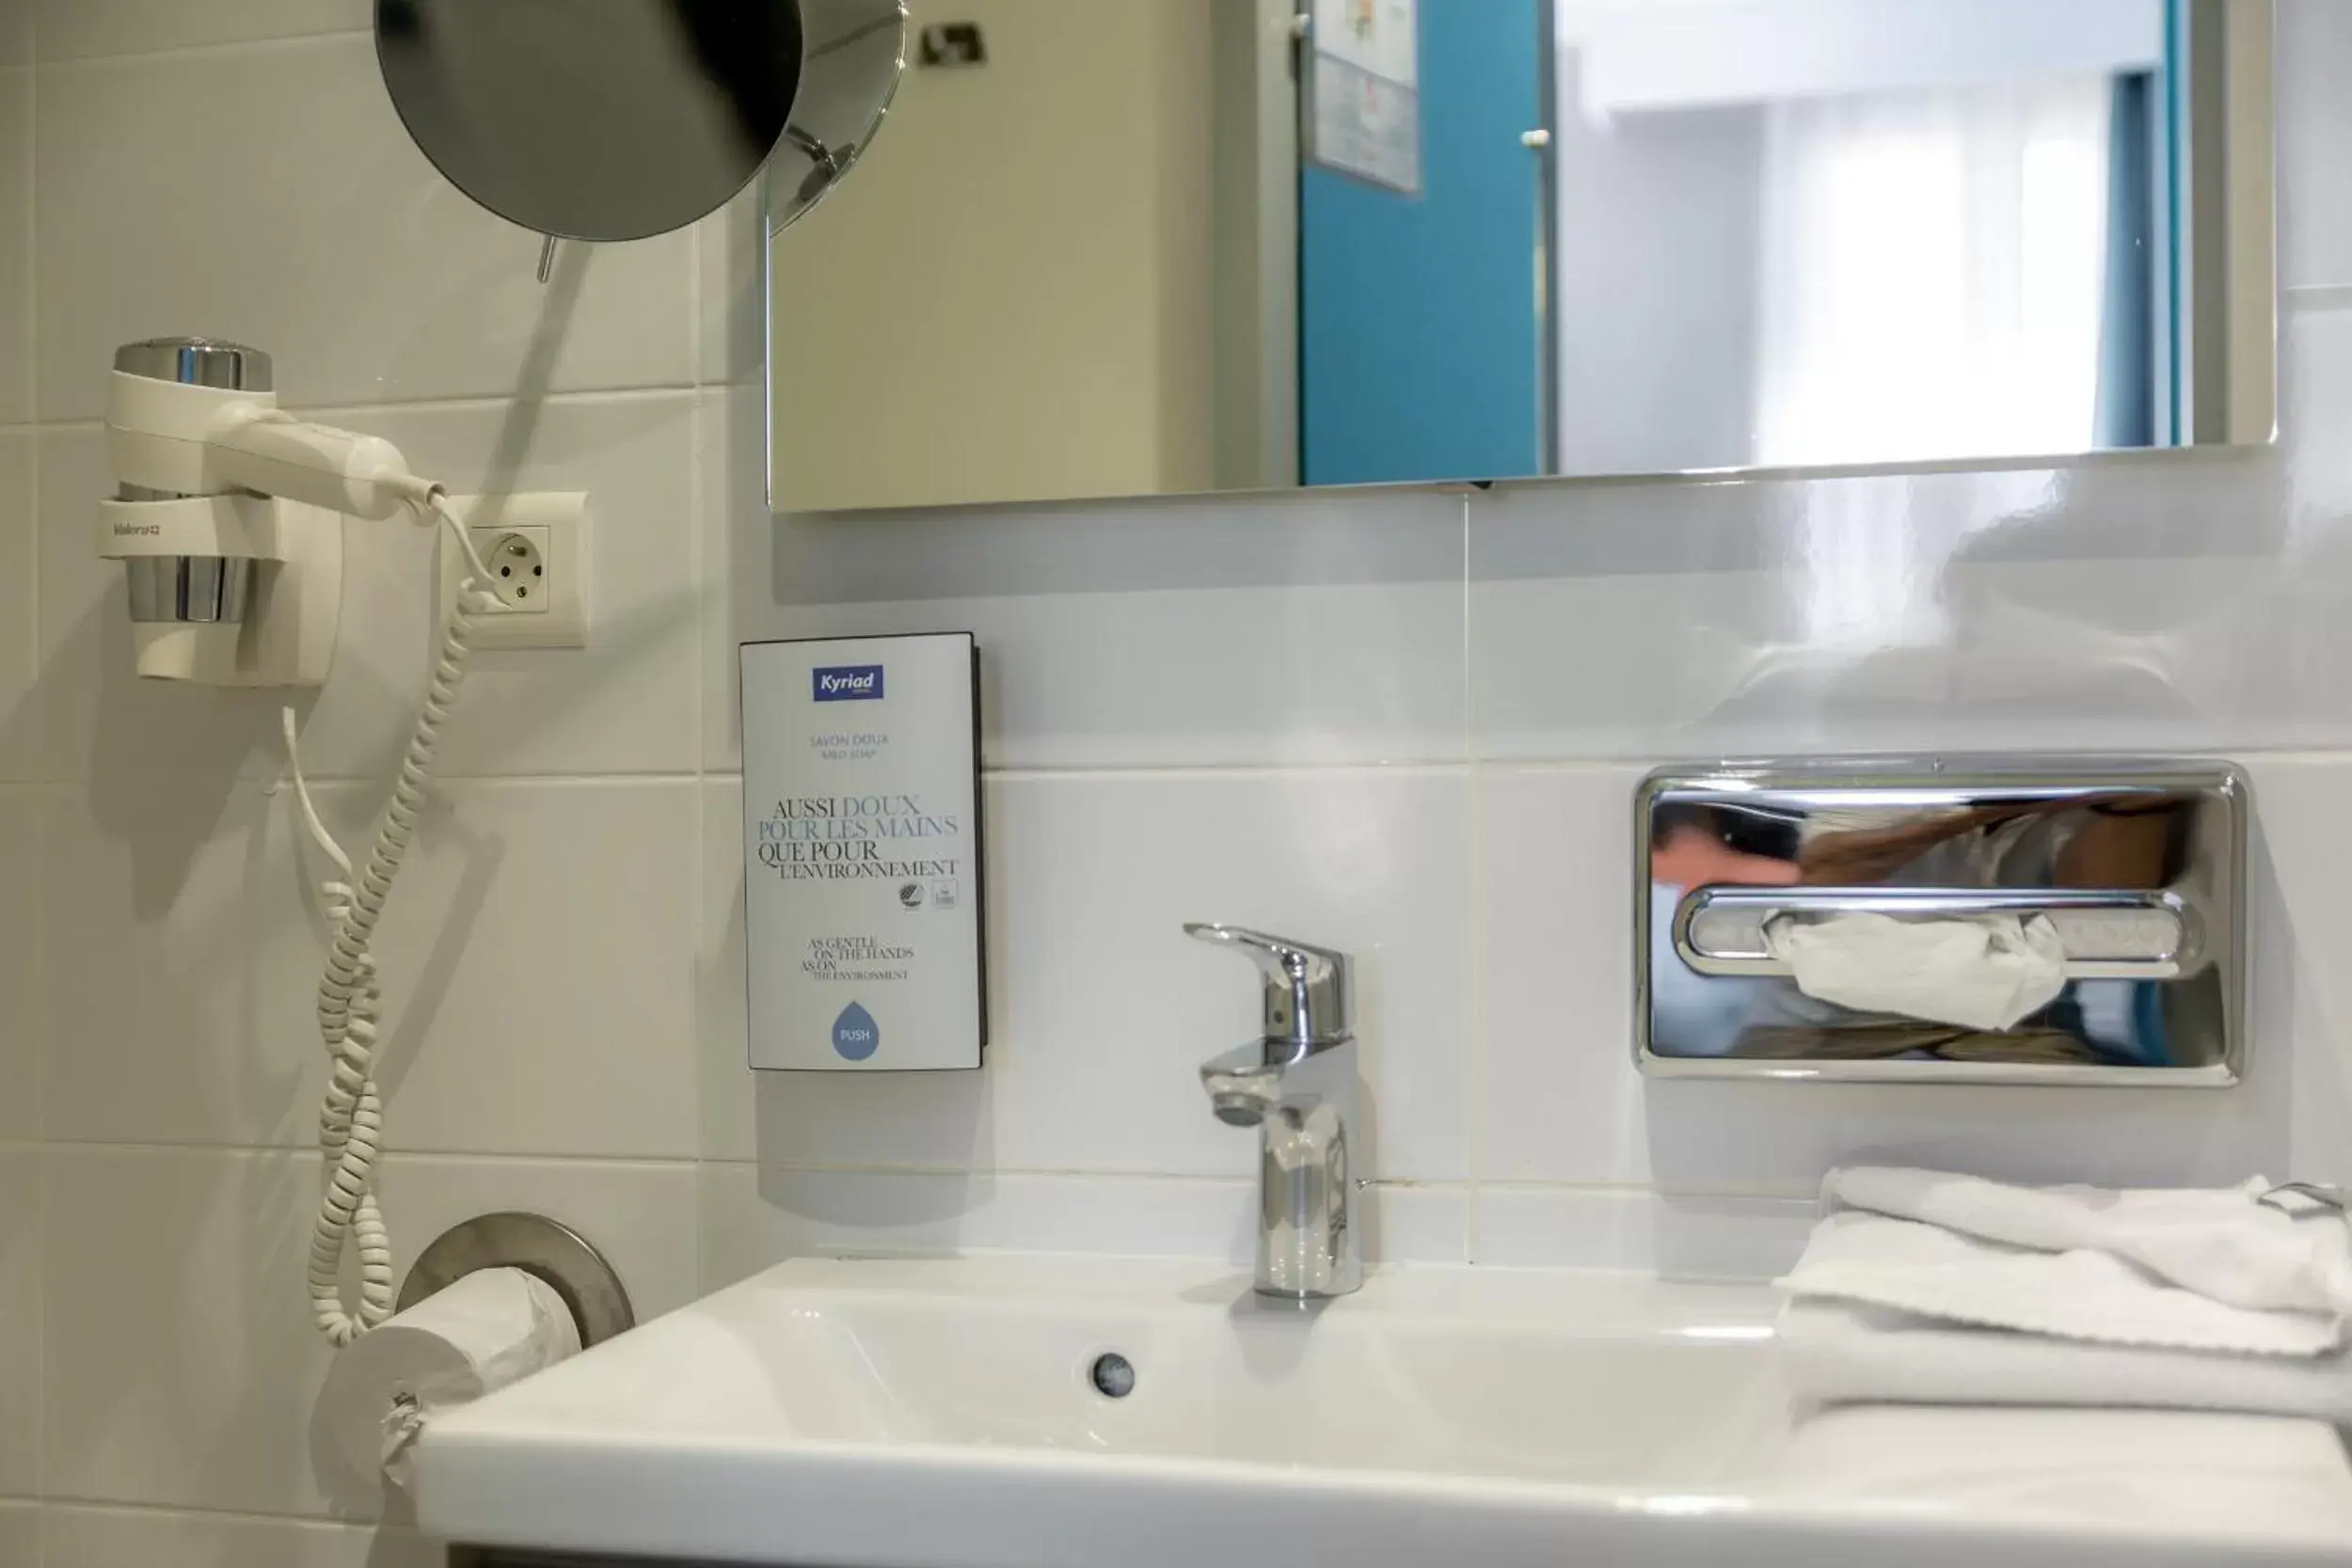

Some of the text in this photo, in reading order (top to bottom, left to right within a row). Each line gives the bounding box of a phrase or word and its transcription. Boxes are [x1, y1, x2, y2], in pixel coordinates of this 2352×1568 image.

[821, 672, 873, 693] Kyriad
[810, 734, 889, 747] SAVON DOUX
[773, 795, 920, 818] AUSSI DOUX
[758, 816, 958, 841] POUR LES MAINS
[758, 841, 879, 867] QUE POUR
[779, 860, 958, 879] L'ENVIRONNEMENT
[808, 937, 877, 949] AS GENTLE
[815, 948, 914, 960] ON THE HANDS
[801, 960, 835, 972] AS ON
[834, 970, 908, 980] ENVIRONMENT
[840, 1029, 870, 1041] PUSH
